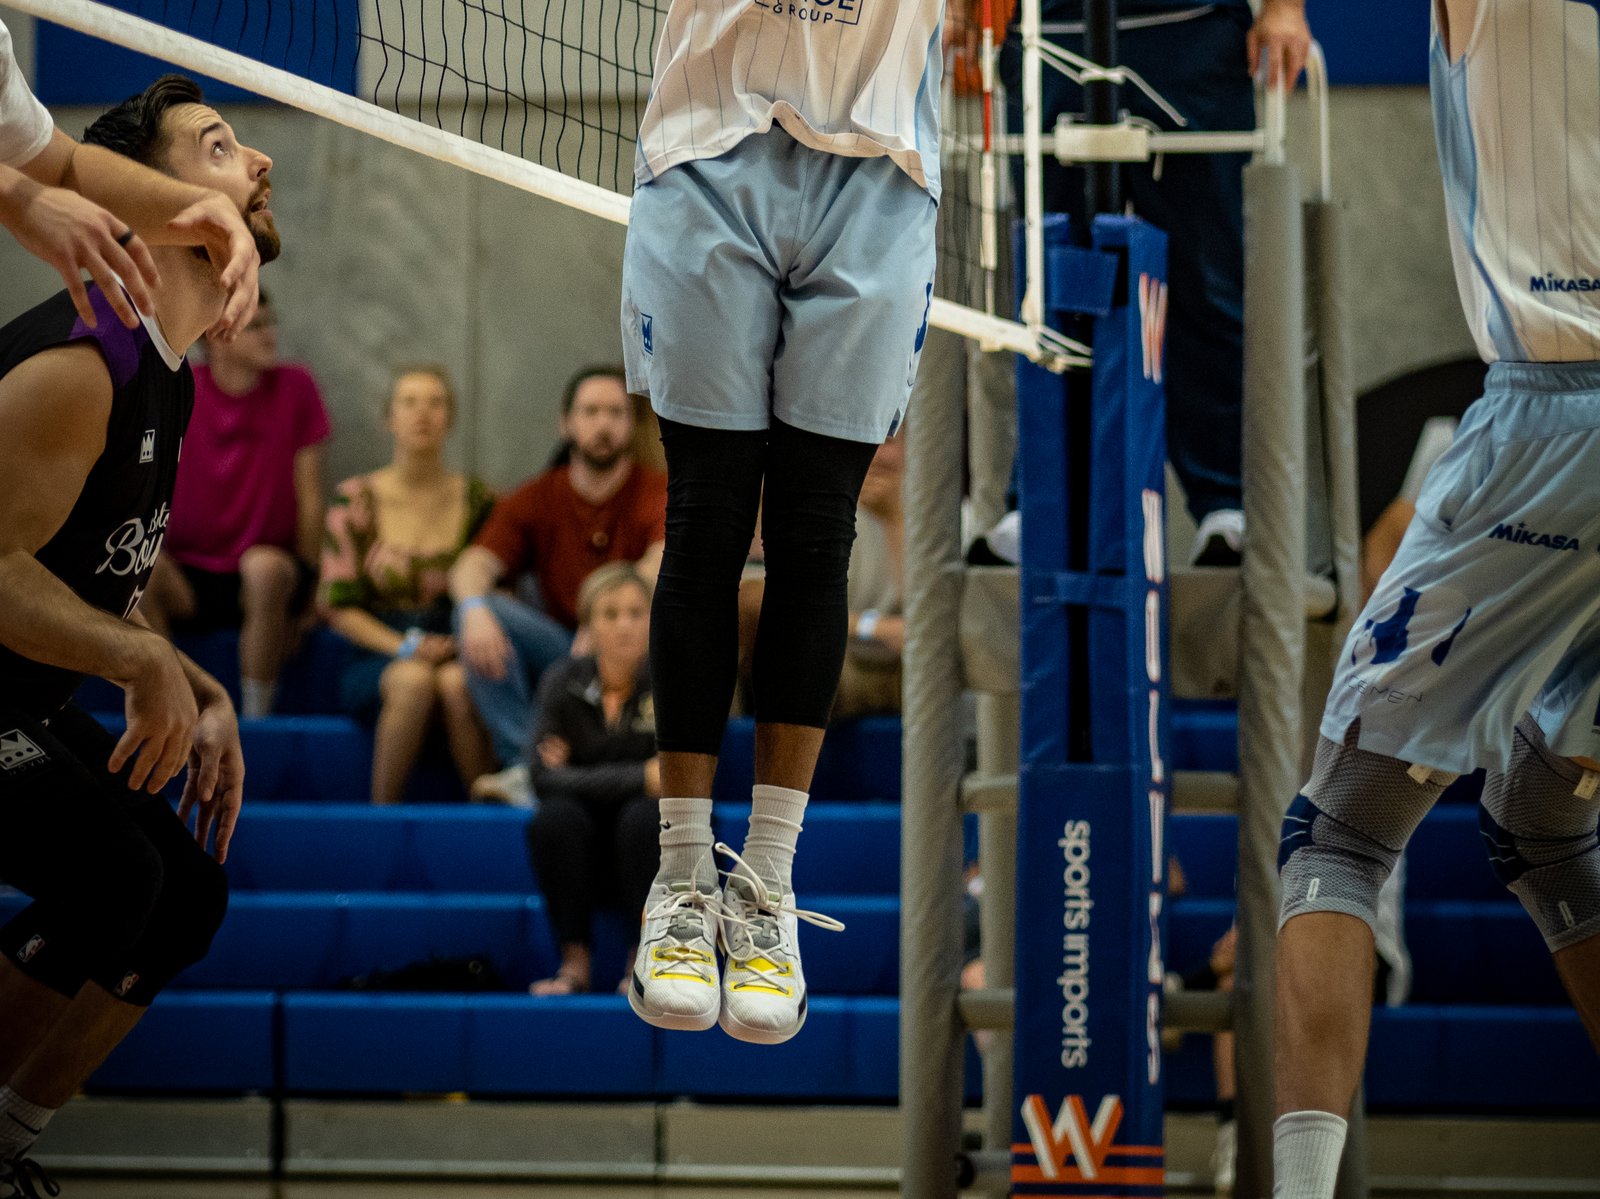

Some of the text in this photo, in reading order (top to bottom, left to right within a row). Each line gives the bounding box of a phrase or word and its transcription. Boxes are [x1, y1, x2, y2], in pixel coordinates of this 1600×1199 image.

[772, 3, 834, 24] GROUP
[1057, 819, 1094, 1069] sports imports
